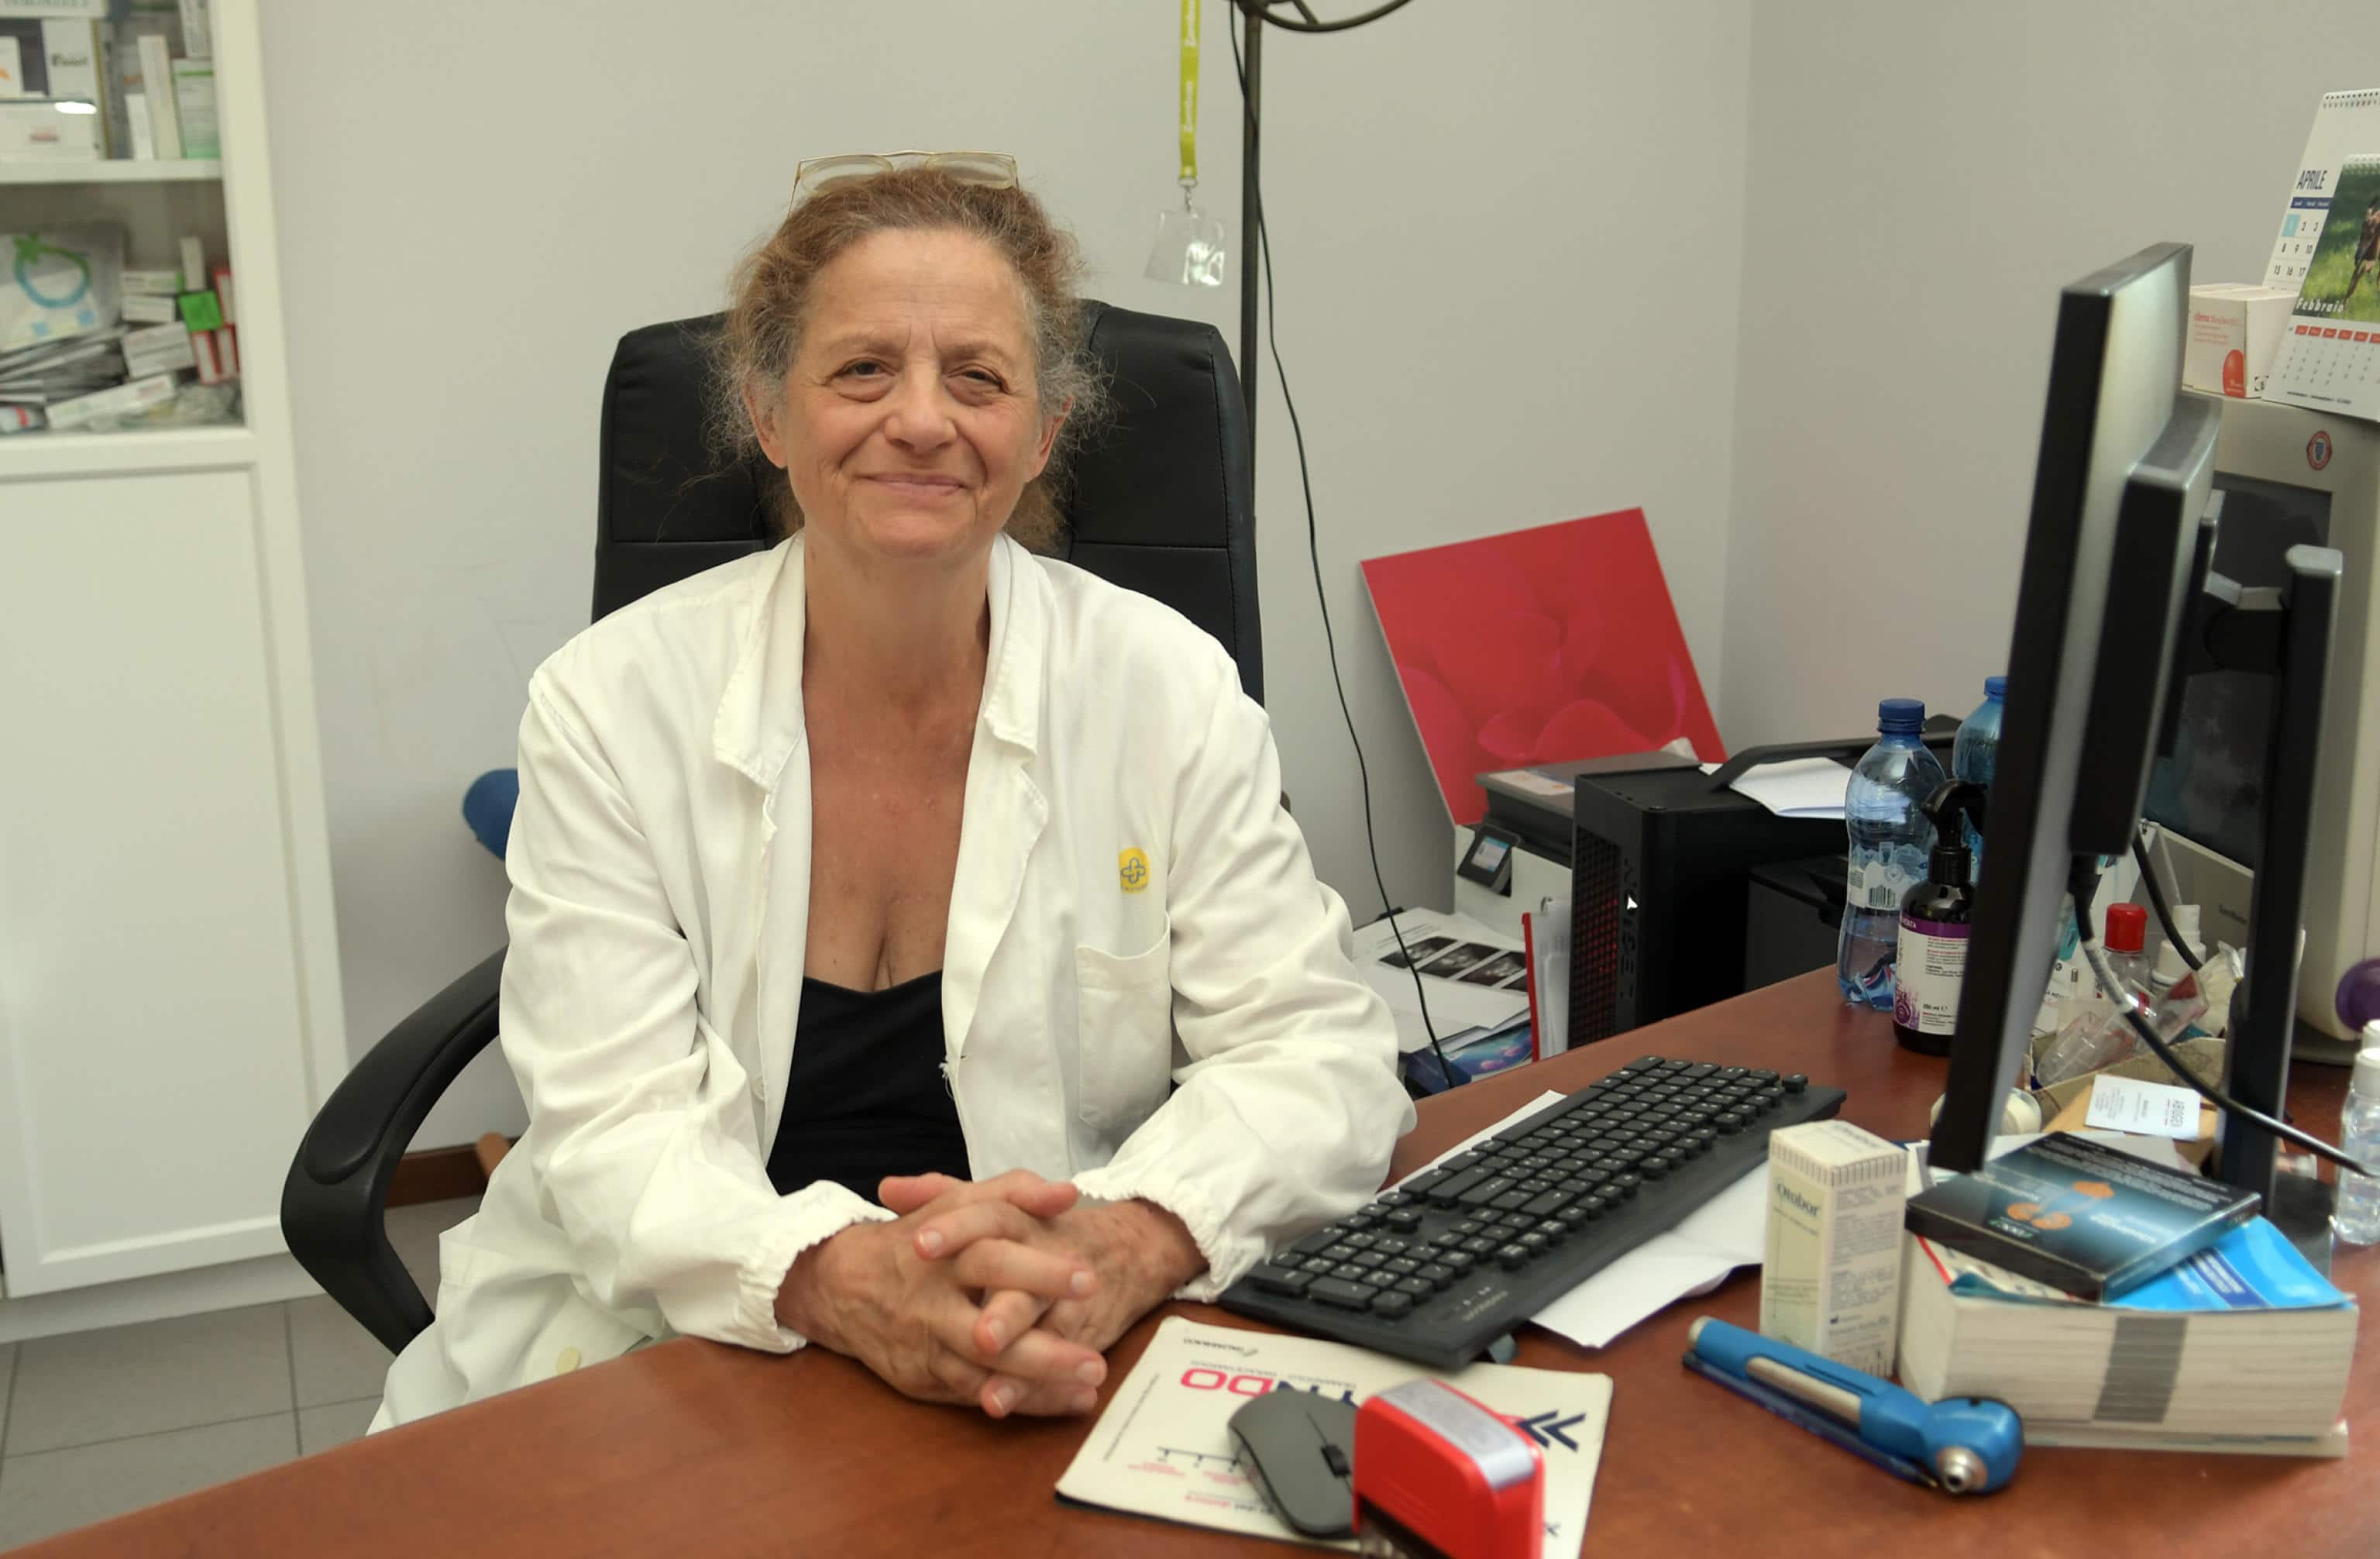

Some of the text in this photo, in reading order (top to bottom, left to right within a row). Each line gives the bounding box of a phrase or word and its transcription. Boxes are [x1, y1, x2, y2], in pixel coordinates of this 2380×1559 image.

[2296, 170, 2328, 190] APRILE
[2301, 221, 2307, 232] 2
[2295, 244, 2300, 253] 9
[2306, 245, 2313, 254] 10
[2296, 298, 2344, 313] Febbraio
